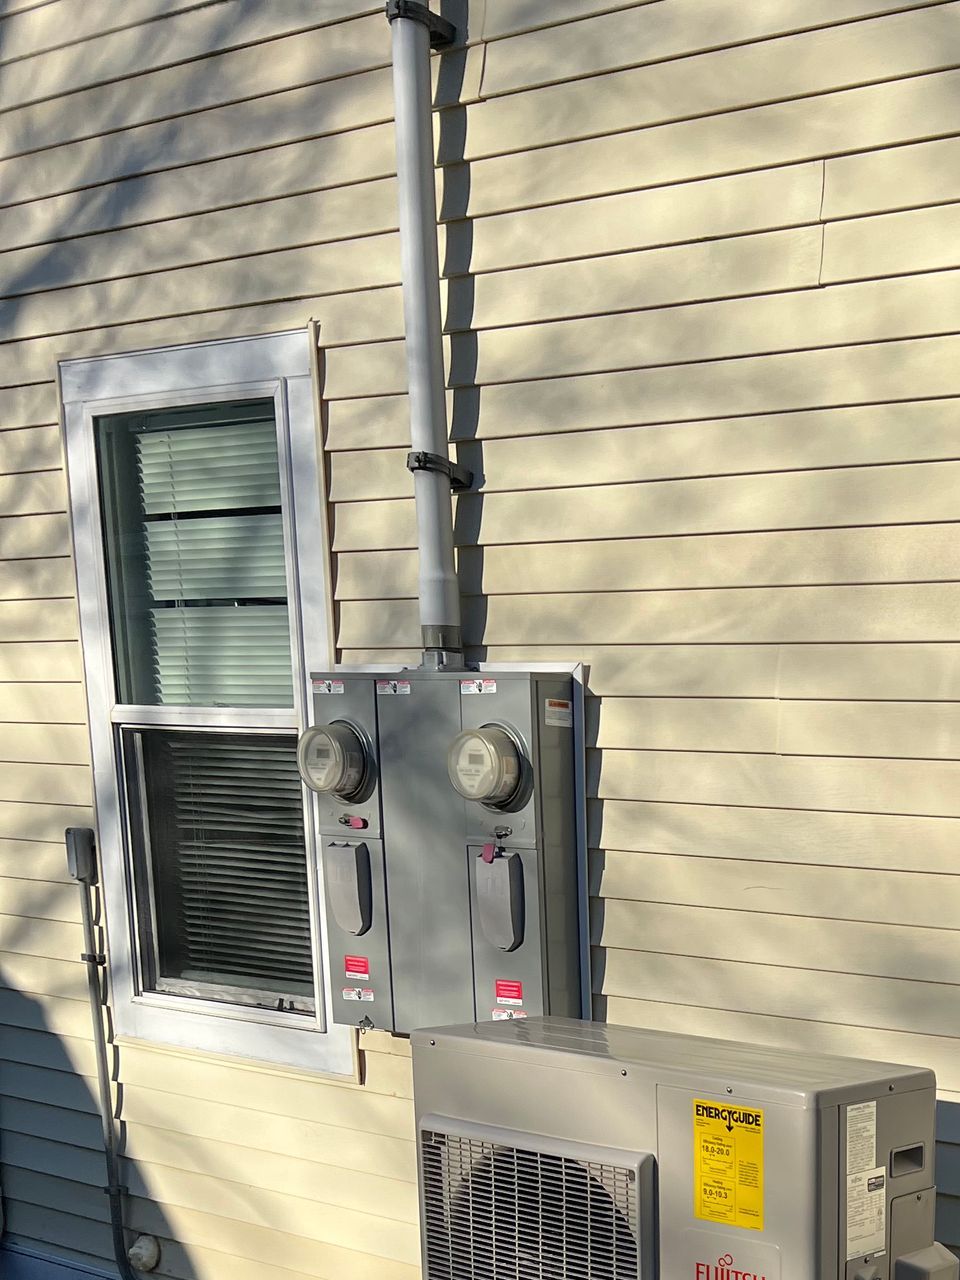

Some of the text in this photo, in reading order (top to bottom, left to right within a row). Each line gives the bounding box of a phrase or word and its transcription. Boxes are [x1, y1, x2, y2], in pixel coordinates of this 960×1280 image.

[695, 1104, 762, 1127] ENERGYGUIDE
[702, 1144, 730, 1157] 18.0-20.0
[703, 1187, 728, 1200] 9.0-10.3
